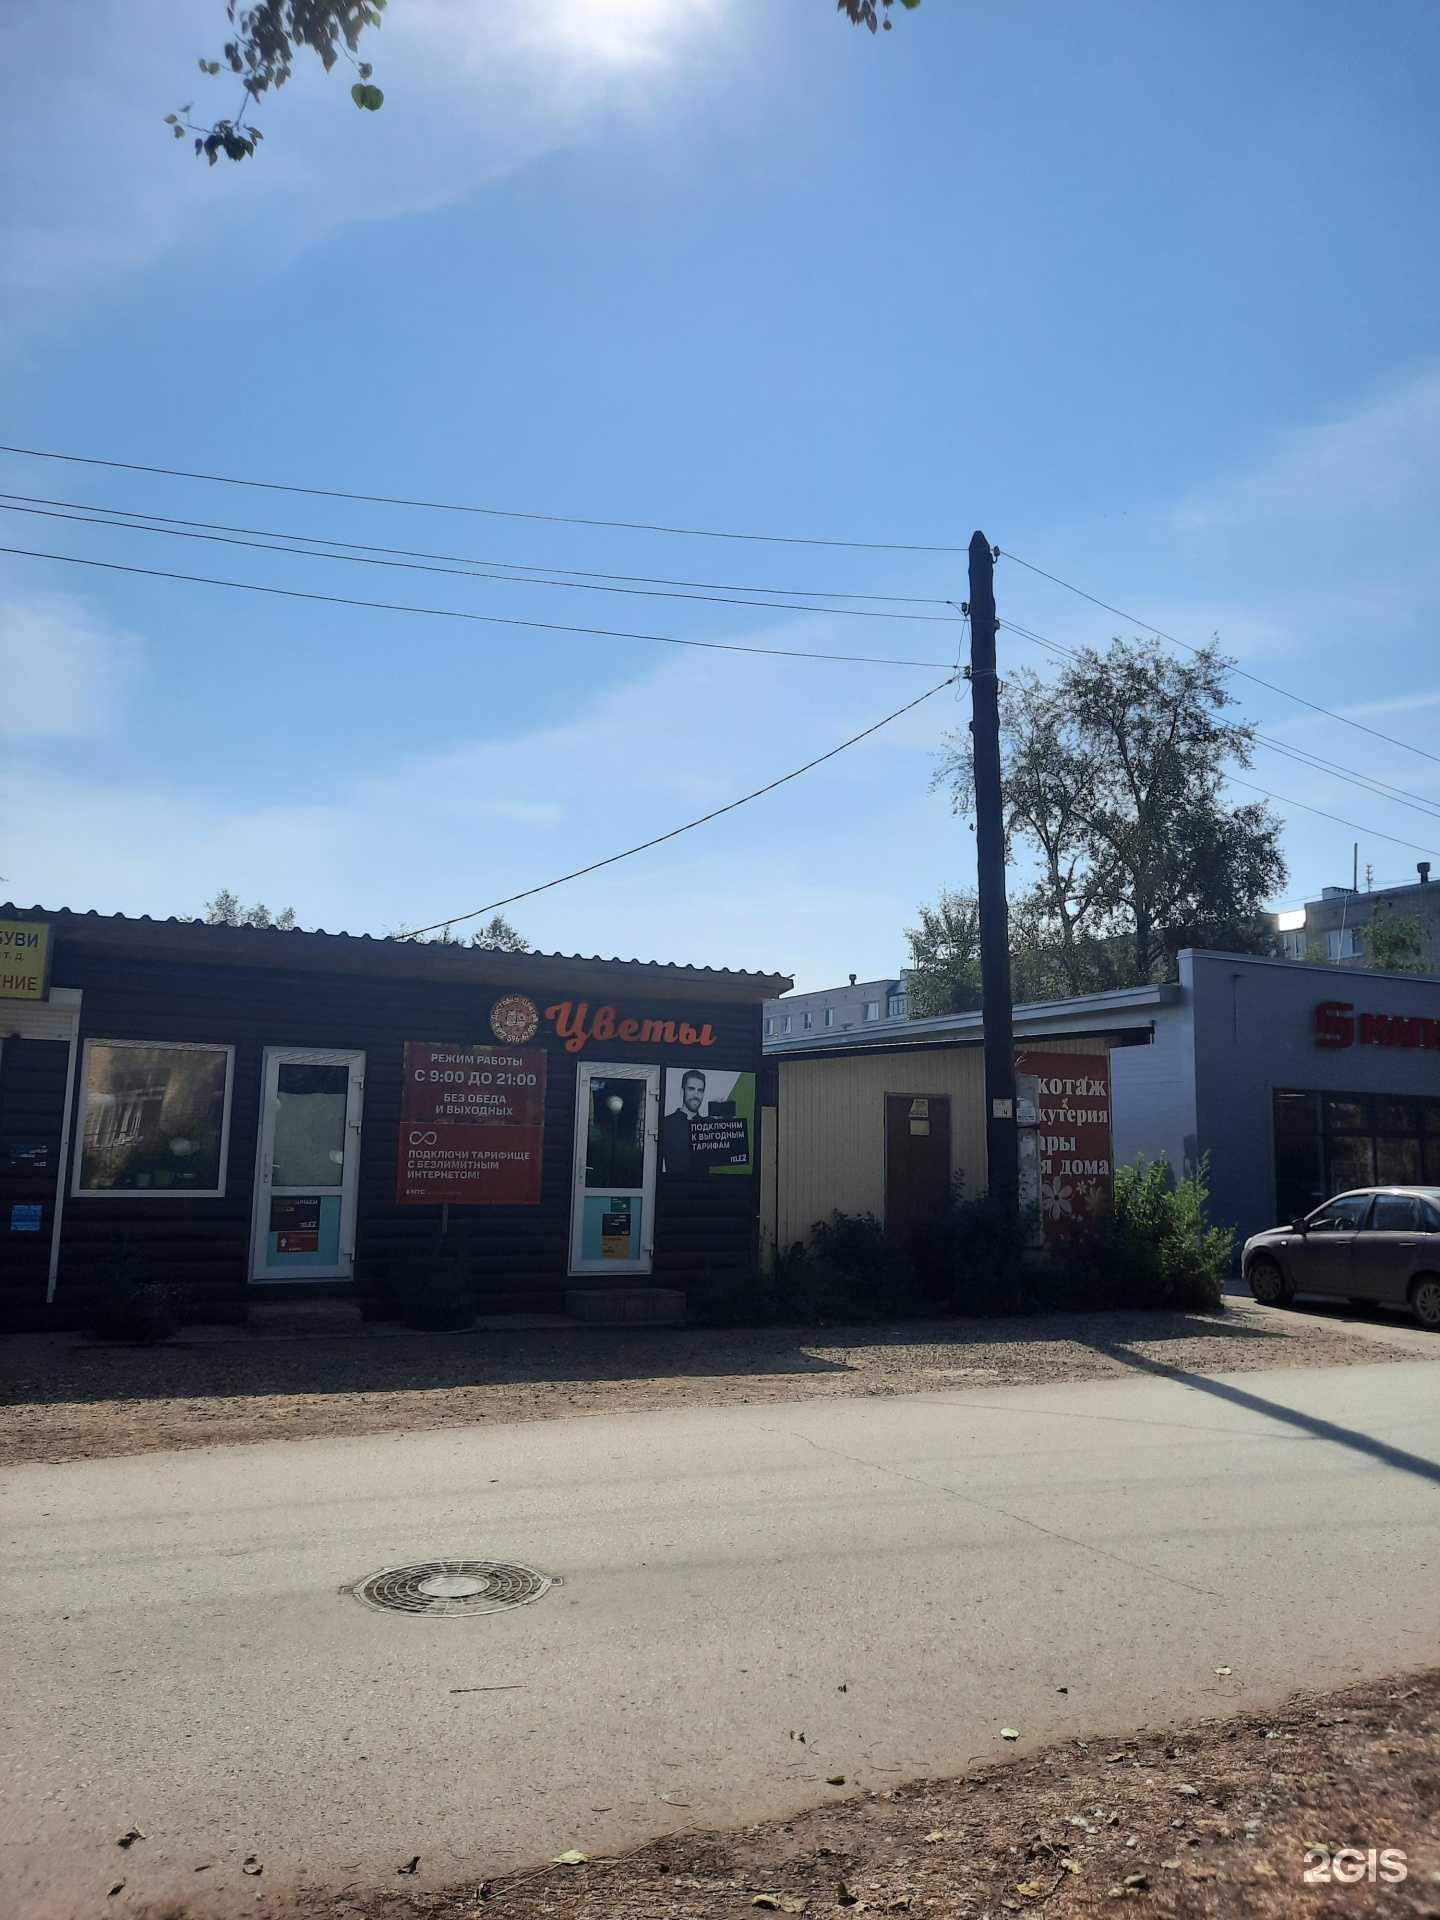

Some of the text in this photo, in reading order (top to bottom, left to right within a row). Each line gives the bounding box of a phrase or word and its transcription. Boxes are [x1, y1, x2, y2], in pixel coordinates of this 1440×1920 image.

[0, 974, 38, 991] НИЕ
[544, 1001, 717, 1052] Цветы
[431, 1053, 523, 1066] РЕЖИМ РАБОТЫ
[414, 1069, 537, 1086] С 9:00 ДО 21:00
[444, 1093, 507, 1105] БЕЗ ОБЕДА
[435, 1105, 513, 1116] И ВЫХОДНЫХ
[690, 1121, 743, 1132] ПОДКЛЮЧИМ
[691, 1130, 745, 1141] К ВЫГОДНЫМ
[692, 1141, 731, 1151] ТАРИФАМ
[408, 1150, 530, 1161] ПОДКЛЮЧИ ТАРИФИЩЕ
[417, 1161, 500, 1169] БЕЗЛИМИТНЫМ
[1060, 1159, 1109, 1176] дома
[407, 1170, 480, 1179] ИНТЕРНЕТОМ!
